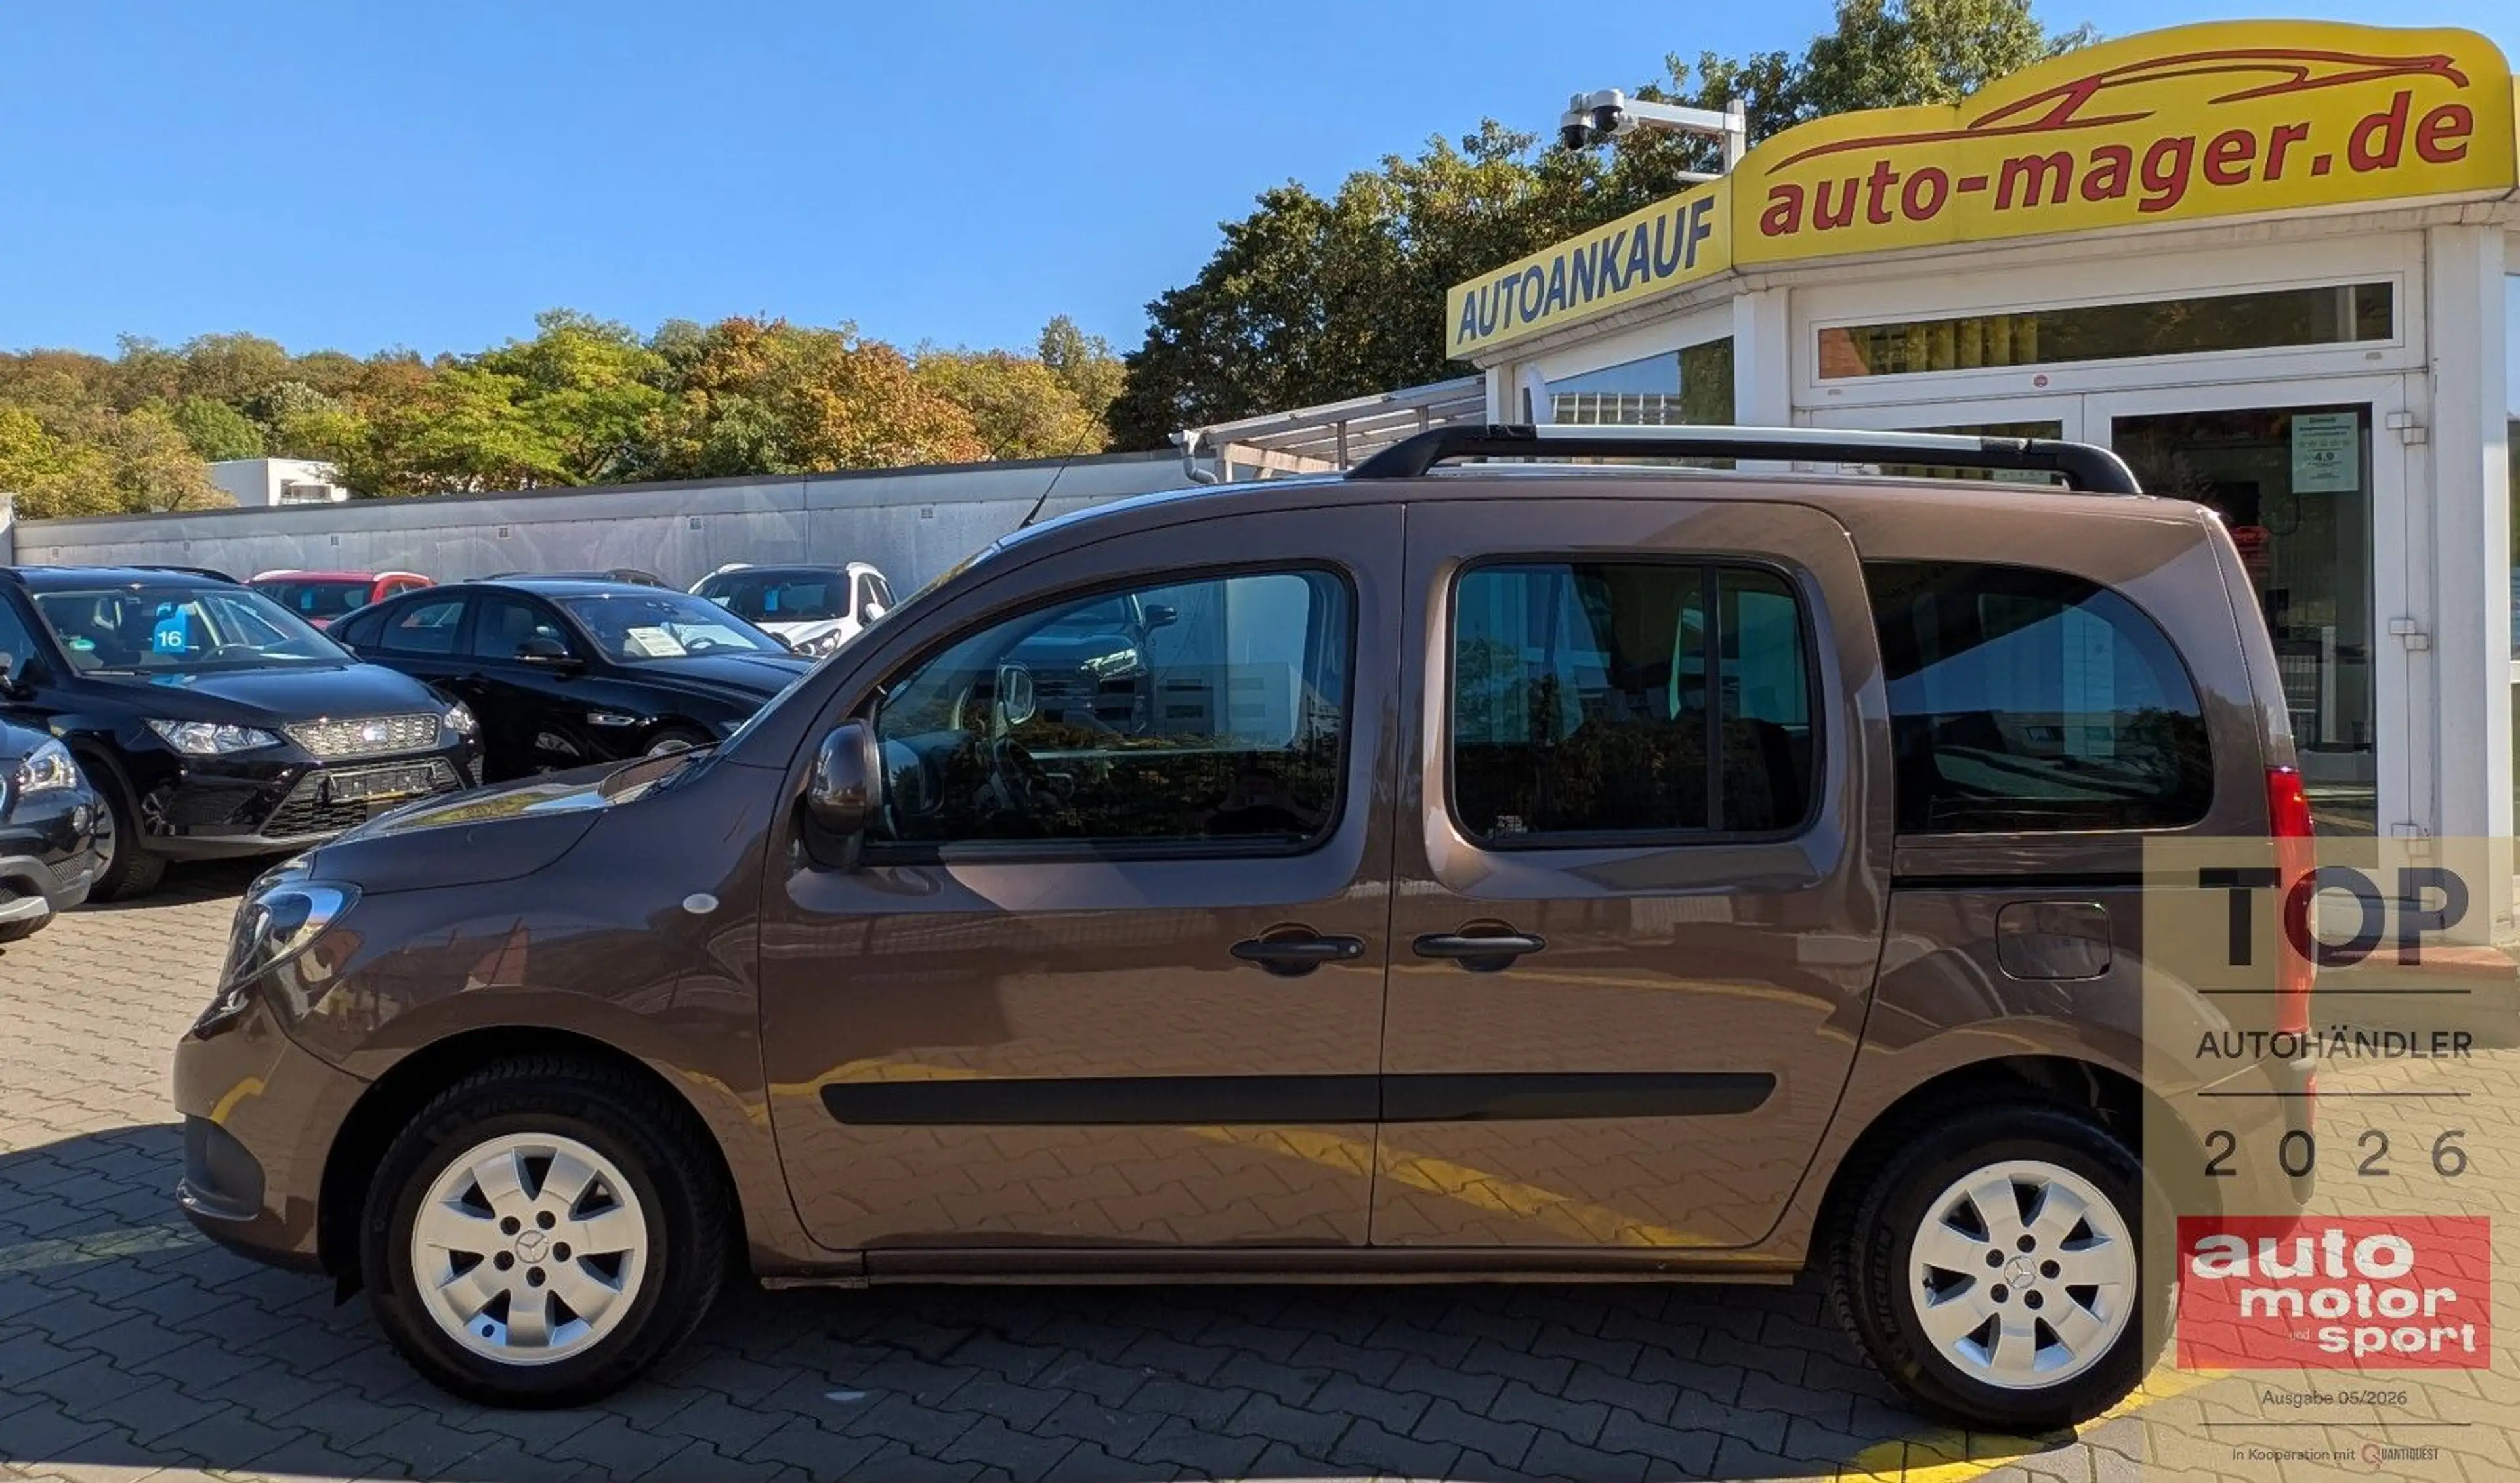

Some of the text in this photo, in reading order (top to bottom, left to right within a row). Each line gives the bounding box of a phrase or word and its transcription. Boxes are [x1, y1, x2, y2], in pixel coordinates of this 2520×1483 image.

[1759, 91, 2472, 237] auto-mager.de
[1457, 195, 1714, 345] AUTOANKAUF
[158, 631, 182, 646] 16
